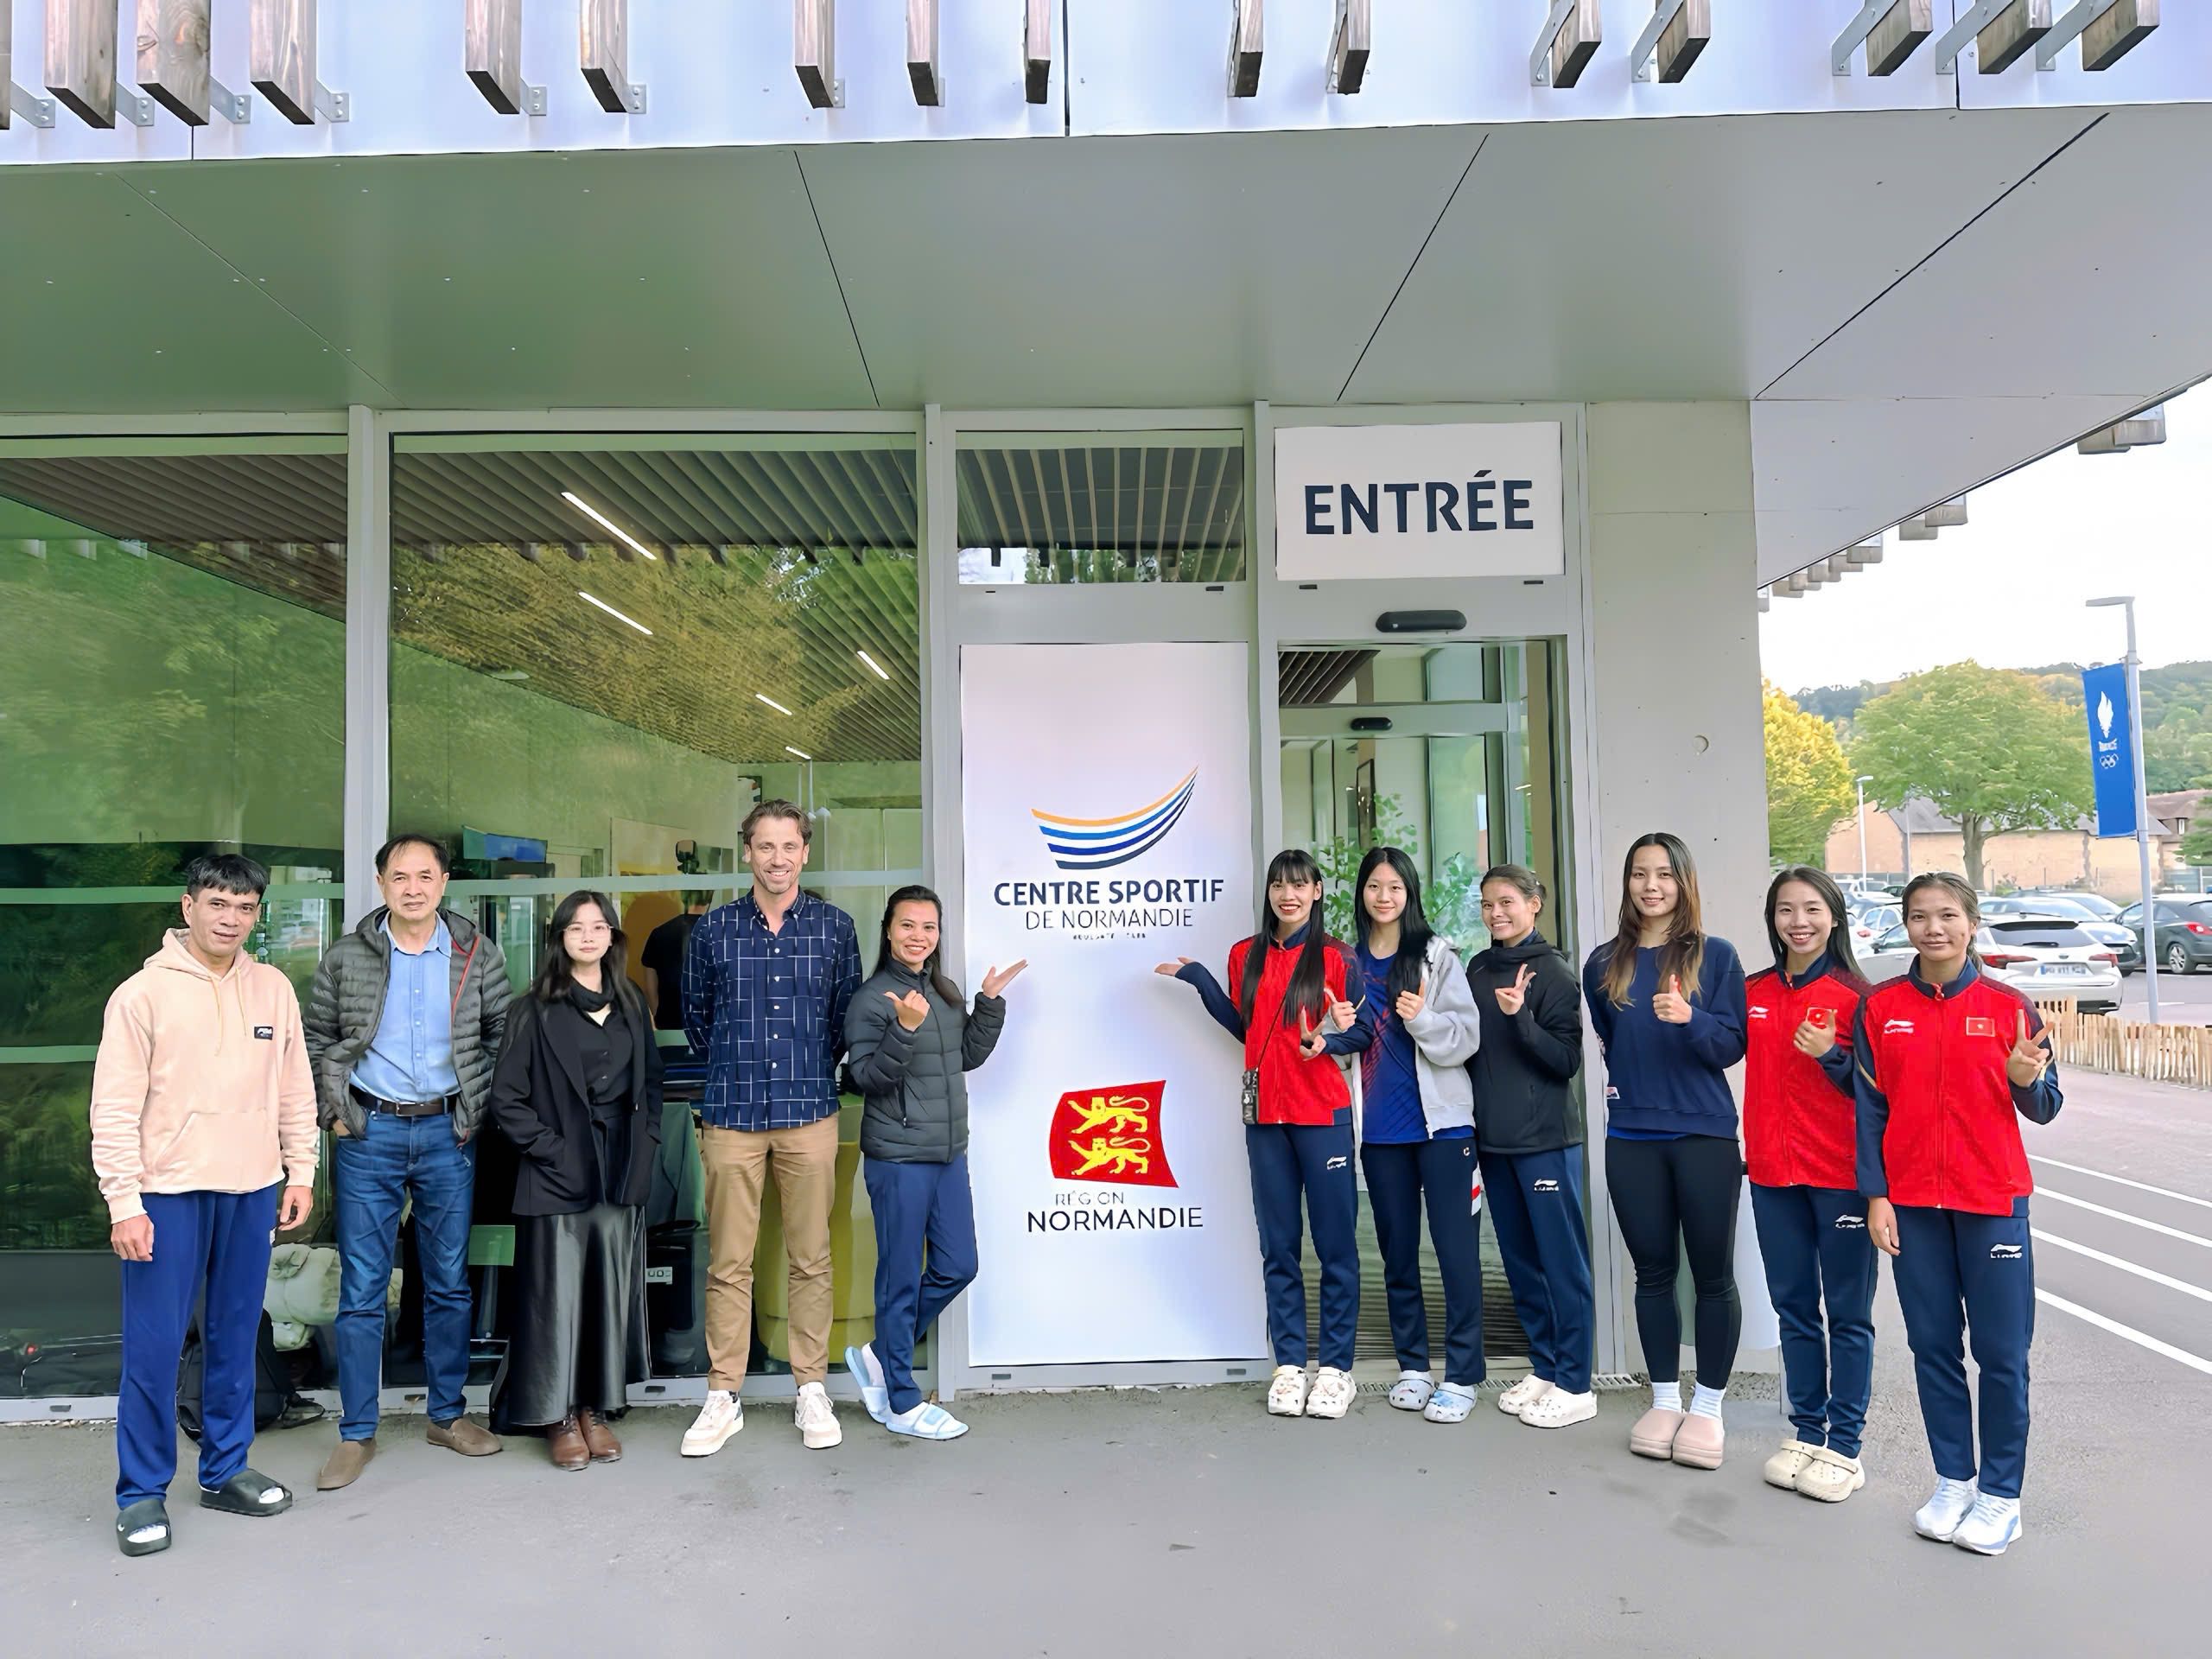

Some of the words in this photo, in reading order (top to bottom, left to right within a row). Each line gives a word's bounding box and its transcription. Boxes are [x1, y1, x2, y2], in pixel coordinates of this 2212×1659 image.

[1304, 469, 1534, 535] ENTRÉE
[994, 881, 1100, 906] CENTRE
[1109, 879, 1224, 905] SPORTIF
[1026, 911, 1054, 931] DE
[1062, 908, 1193, 929] NORMANDIE
[1055, 1190, 1124, 1206] RÉGON
[1027, 1207, 1204, 1233] NORMANDIE
